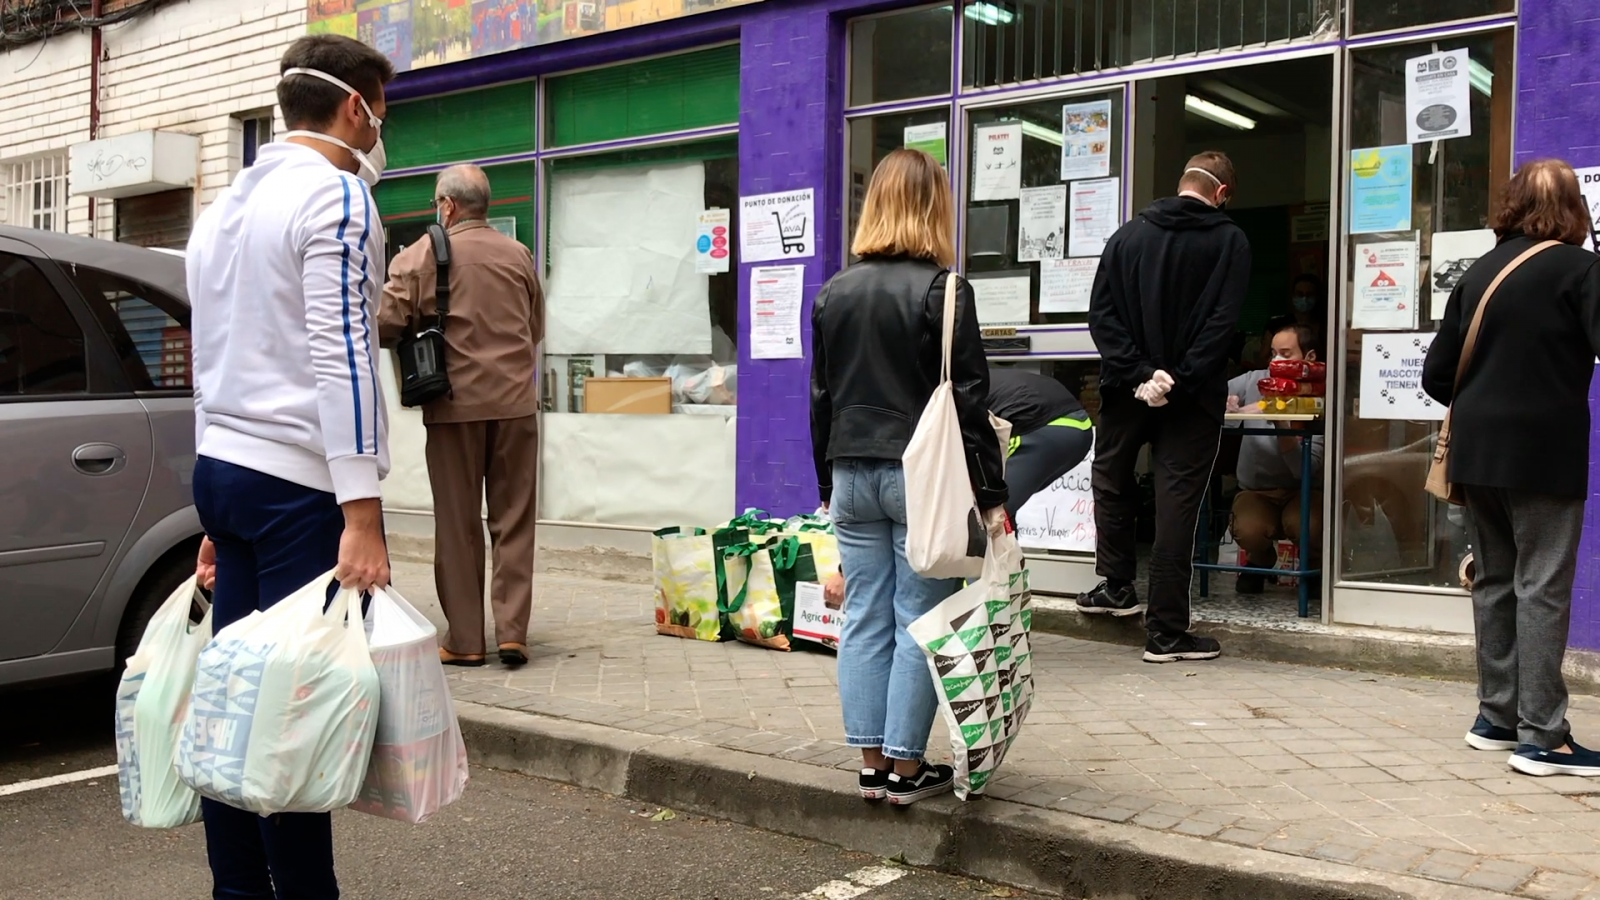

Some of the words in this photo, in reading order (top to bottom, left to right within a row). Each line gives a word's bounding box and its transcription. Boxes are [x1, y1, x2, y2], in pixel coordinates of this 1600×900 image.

[744, 199, 766, 208] PUNTO
[767, 197, 775, 205] DE
[777, 191, 811, 204] DONACIÓN
[783, 224, 802, 233] AVA
[984, 329, 1013, 337] CARTAS
[1385, 380, 1418, 389] TIENEN
